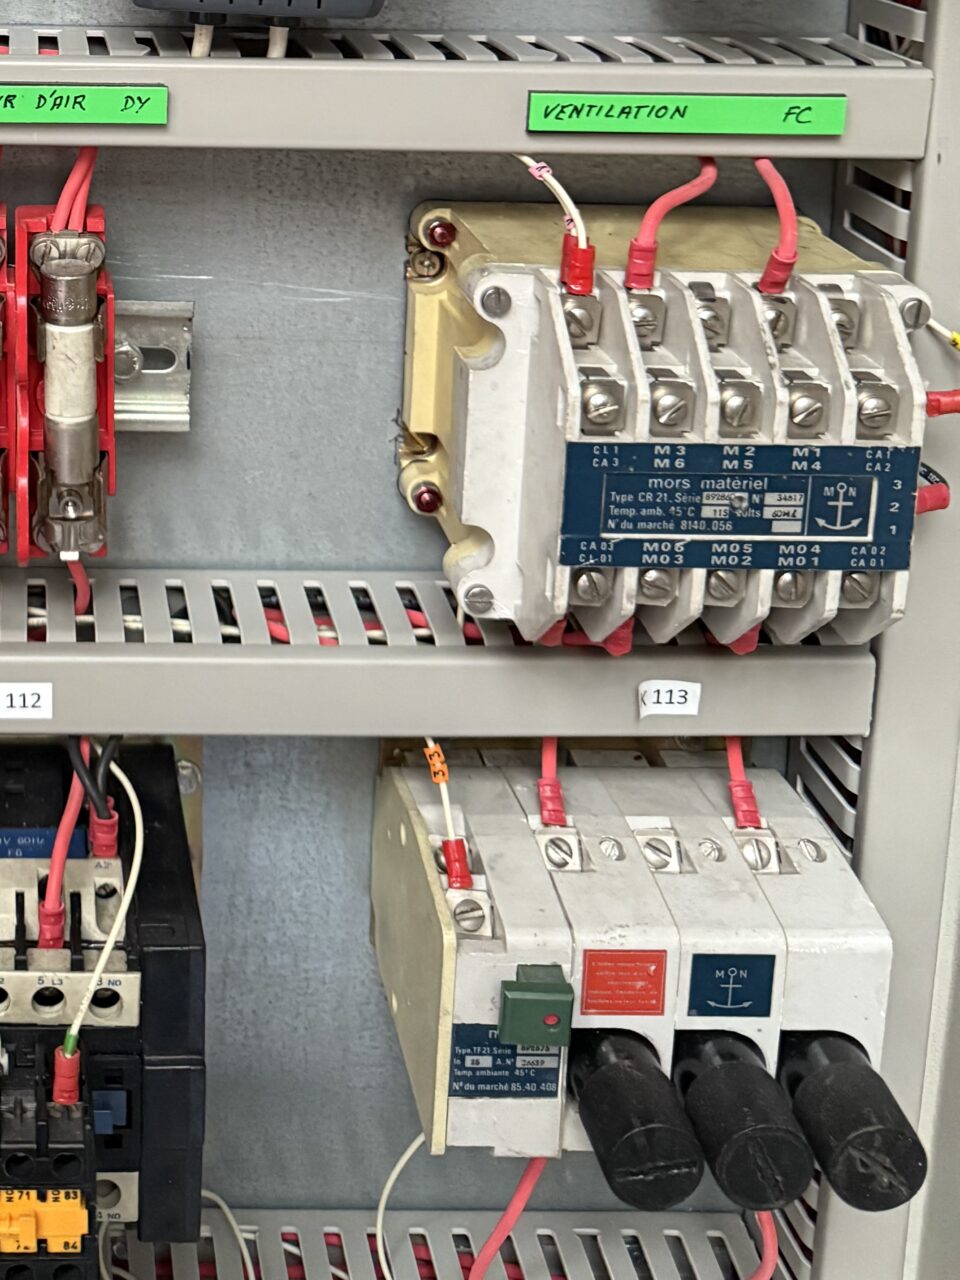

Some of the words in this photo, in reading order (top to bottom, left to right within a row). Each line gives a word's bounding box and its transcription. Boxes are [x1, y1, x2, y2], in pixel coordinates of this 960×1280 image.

[35, 90, 87, 112] D'AIR
[121, 95, 152, 114] DY
[543, 103, 689, 121] VENTILATION
[782, 105, 813, 124] FC
[648, 477, 691, 489] mors
[892, 480, 902, 490] 3
[823, 486, 834, 496] M
[848, 486, 857, 497] N
[610, 491, 634, 503] Type
[638, 492, 654, 502] CR
[890, 503, 900, 512] 2
[620, 520, 633, 529] du
[637, 520, 675, 530] marché
[890, 525, 897, 535] 1
[6, 692, 42, 709] 112
[652, 688, 689, 705] 113
[715, 969, 724, 979] M
[740, 970, 748, 978] N
[37, 976, 45, 985] 5
[464, 1082, 475, 1091] du
[477, 1082, 509, 1091] marché
[18, 1191, 30, 1201] 71
[64, 1190, 78, 1200] 83
[63, 1240, 78, 1250] 84
